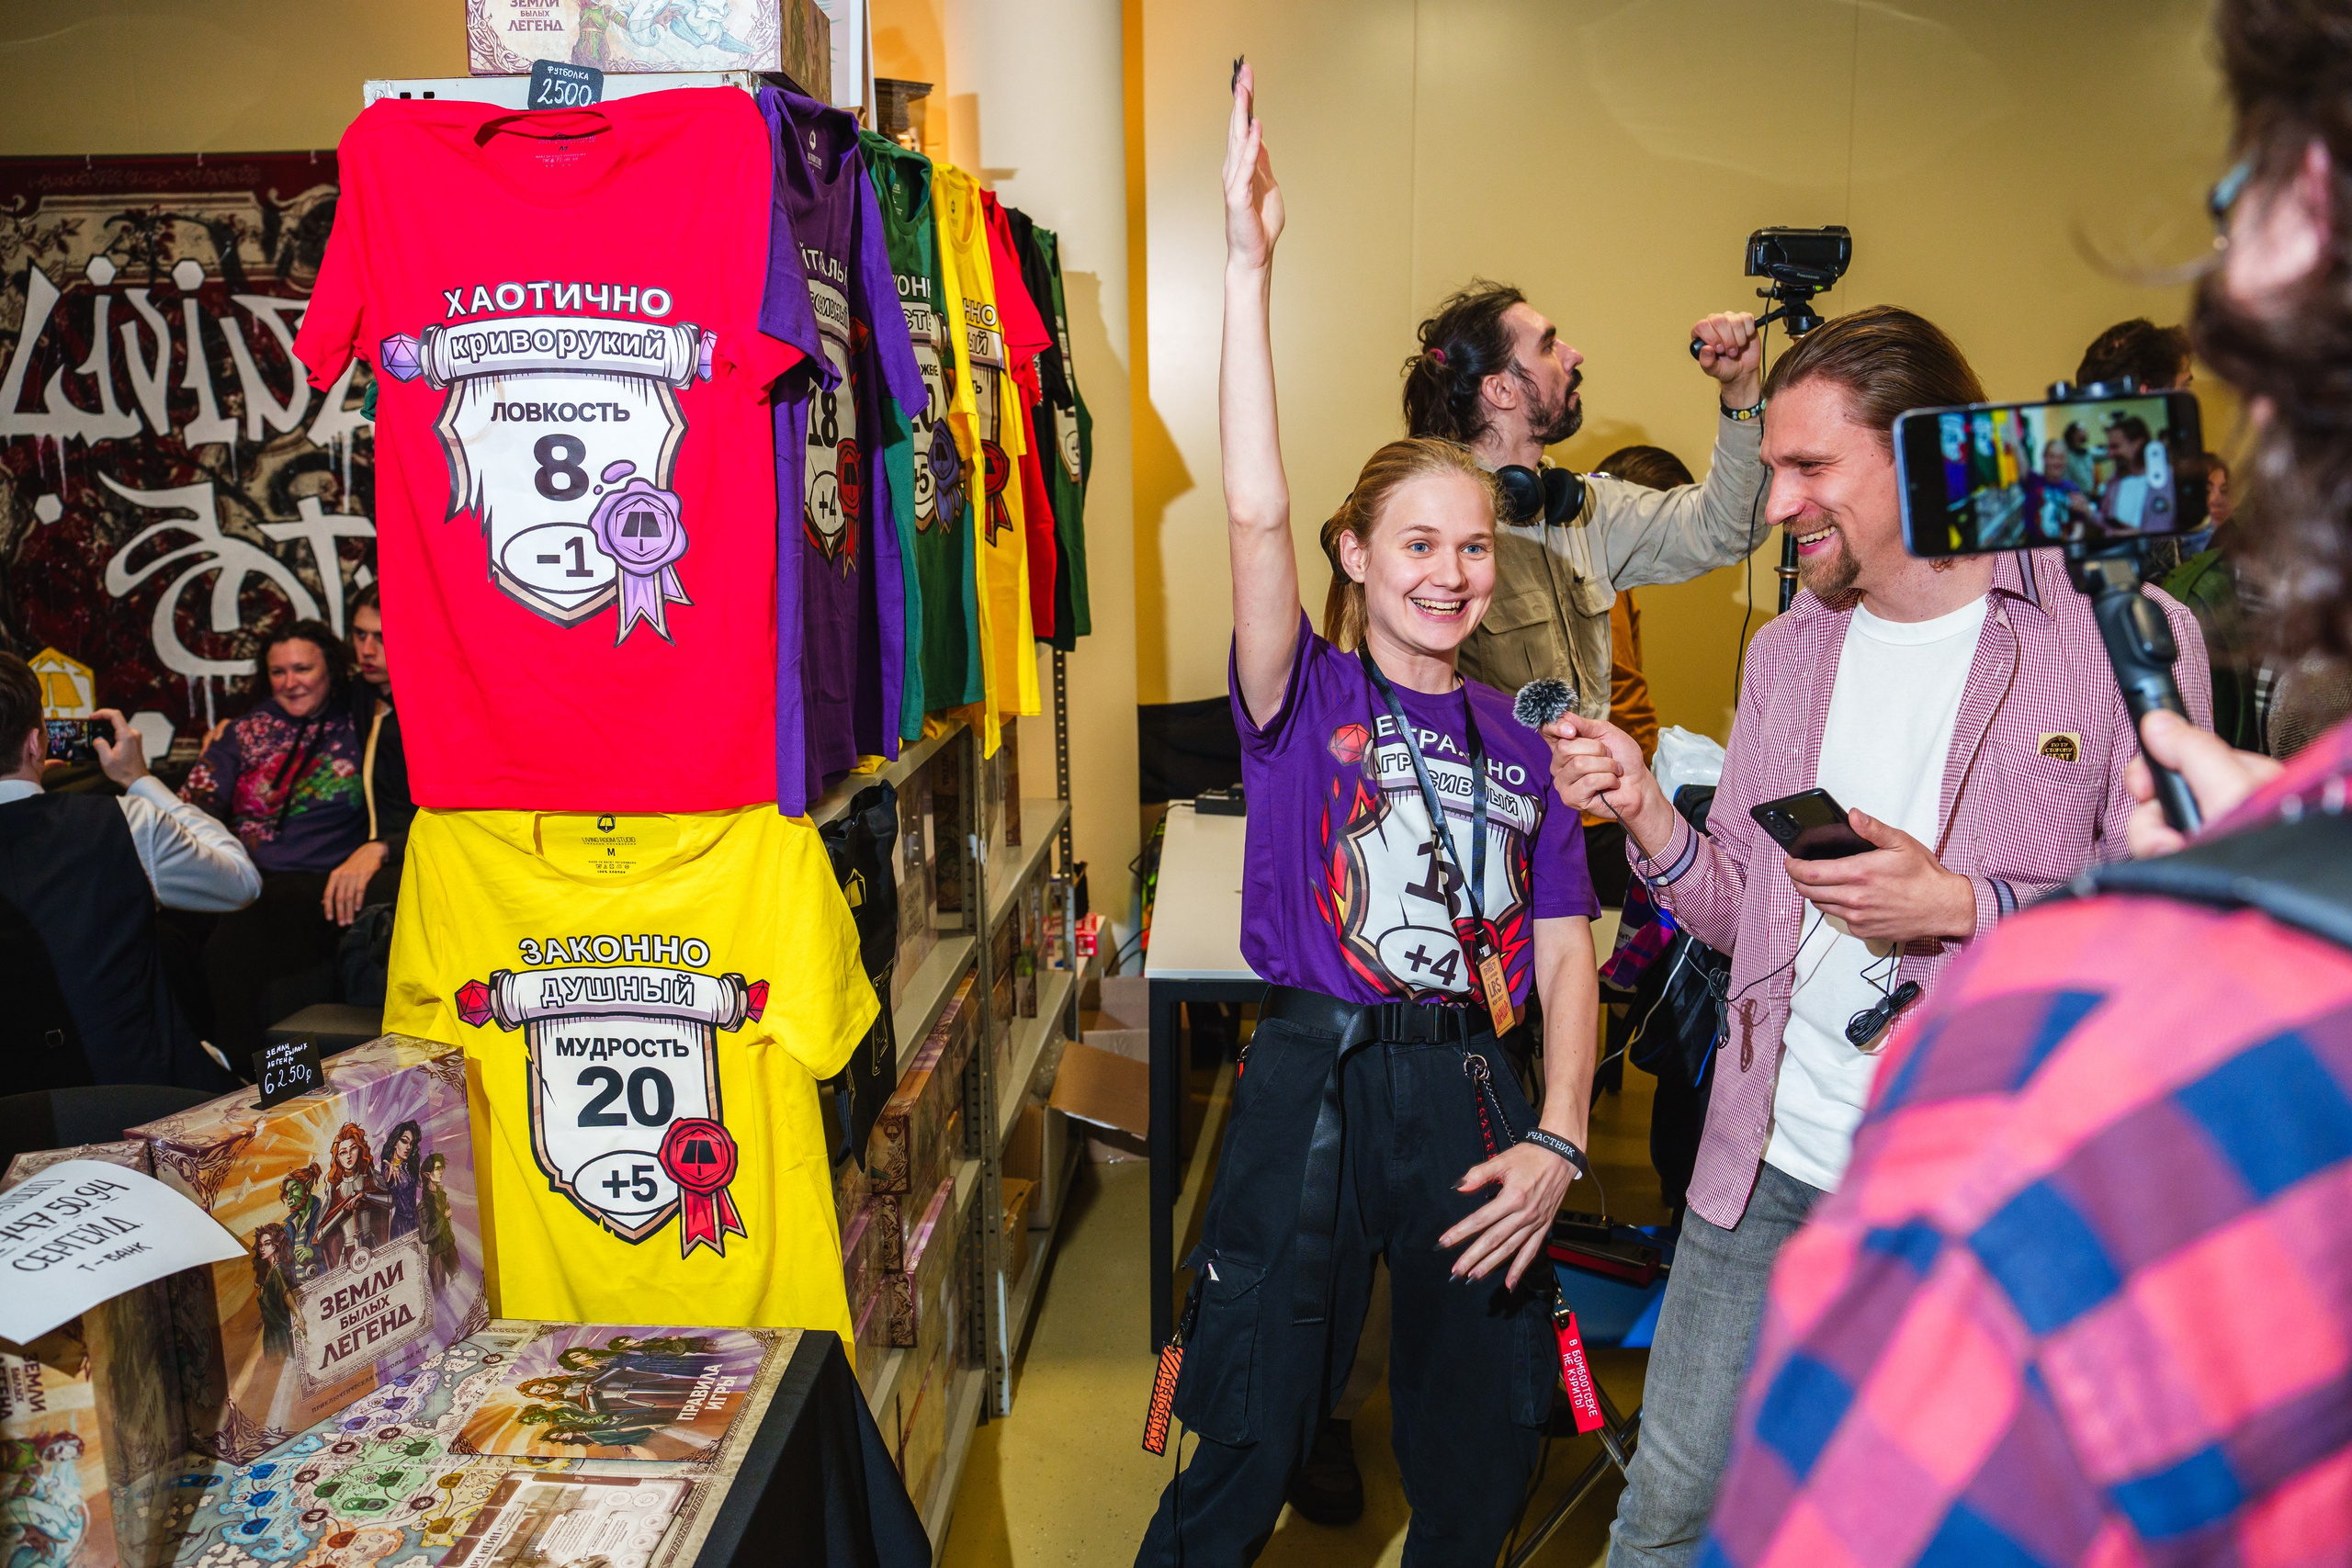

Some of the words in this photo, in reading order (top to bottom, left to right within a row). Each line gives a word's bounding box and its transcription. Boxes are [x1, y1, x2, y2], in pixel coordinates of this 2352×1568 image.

[507, 19, 565, 31] ЛЕГЕНД
[548, 65, 589, 81] ФУТБОЛКА
[443, 281, 673, 319] ХАОТИЧНО
[449, 328, 667, 362] криворукий
[491, 401, 631, 423] ЛОВКОСТЬ
[808, 385, 839, 449] 18
[533, 434, 590, 502] 8
[819, 486, 837, 524] +4
[537, 536, 594, 578] -1
[606, 847, 616, 857] M
[518, 934, 710, 968] ЗАКОННО
[1404, 943, 1460, 987] +4
[540, 976, 695, 1009] ДУШНЫЙ
[1487, 977, 1502, 998] LRS
[555, 1037, 689, 1061] МУДРОСТЬ
[577, 1066, 675, 1129] 20
[1525, 1130, 1576, 1157] УЧАСТНИК
[43, 1196, 92, 1216] 50
[74, 1179, 130, 1201] 94
[601, 1164, 659, 1202] +5
[12, 1223, 119, 1272] СЕРГЕЙ
[320, 1258, 405, 1321] ЗЕМЛИ
[340, 1294, 390, 1331] БЫЛЫХ
[318, 1303, 417, 1371] ЛЕГЕНД
[1568, 1338, 1578, 1347] В
[375, 1351, 415, 1379] НАСТОЛЬНАЯ
[415, 1343, 431, 1357] ИГРА
[1563, 1352, 1574, 1367] НЕ
[675, 1363, 723, 1421] ПРАВИЛА
[704, 1375, 739, 1410] ИГРЫ
[1566, 1368, 1586, 1409] КУРИТЬ!
[1571, 1348, 1599, 1417] БОМБООТСЕКЕ
[1150, 1376, 1171, 1444] PRIORITY
